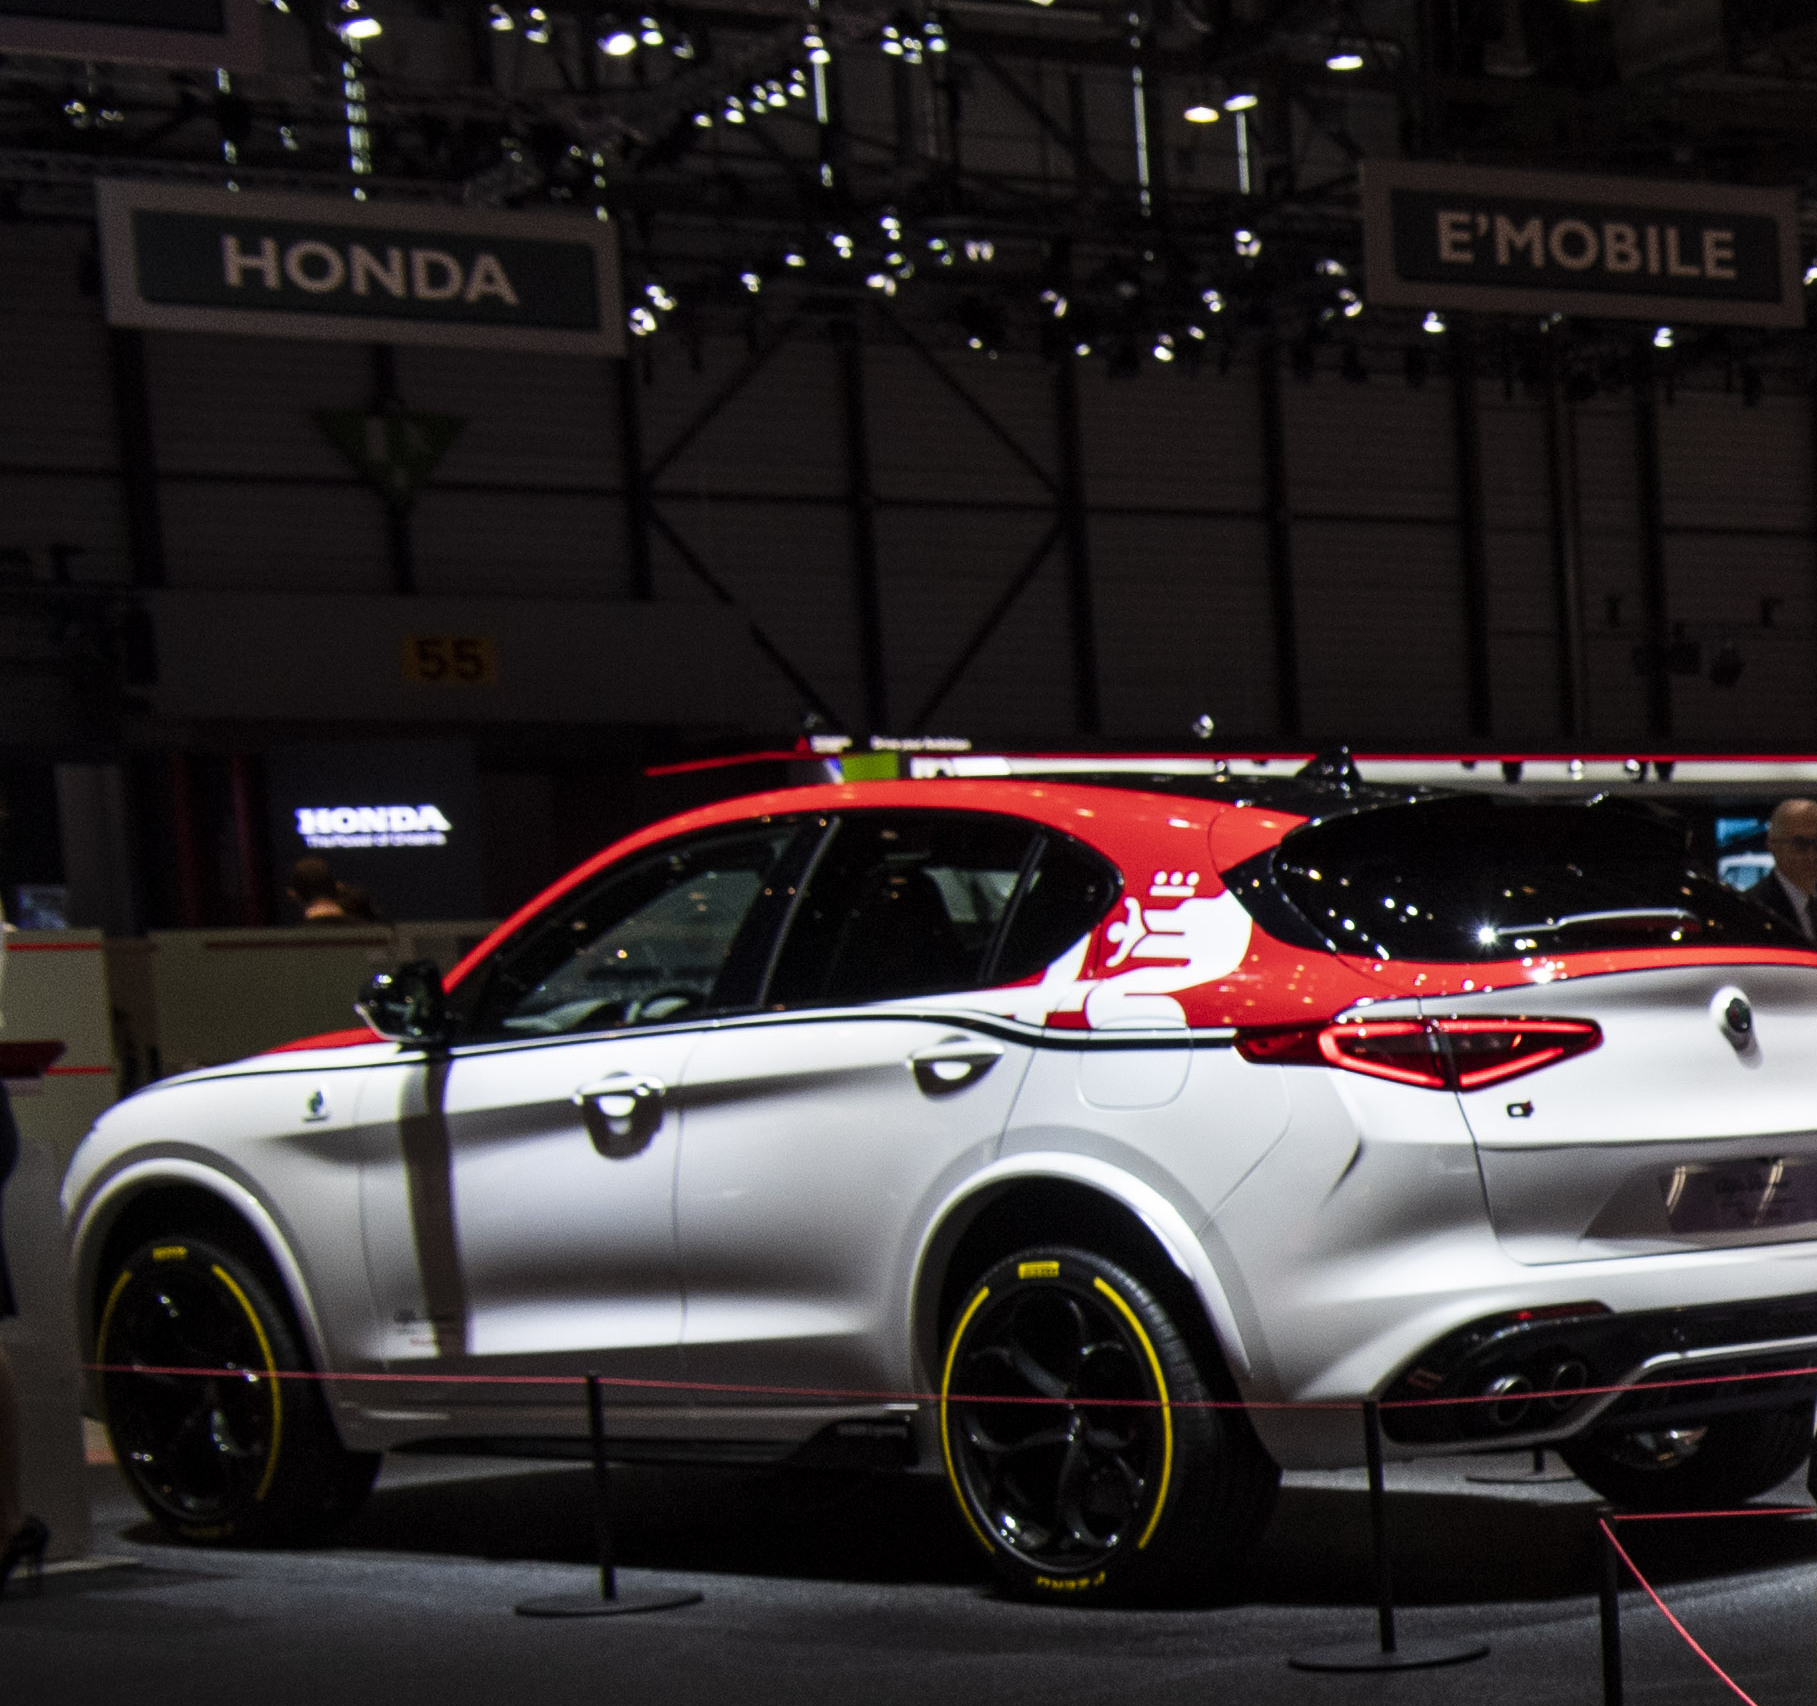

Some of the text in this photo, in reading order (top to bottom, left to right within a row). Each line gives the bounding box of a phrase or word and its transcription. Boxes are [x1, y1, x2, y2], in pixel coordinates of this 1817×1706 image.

[222, 234, 519, 306] HONDA
[1436, 208, 1738, 281] E'MOBILE
[415, 639, 483, 681] 55
[294, 804, 452, 834] HONDA
